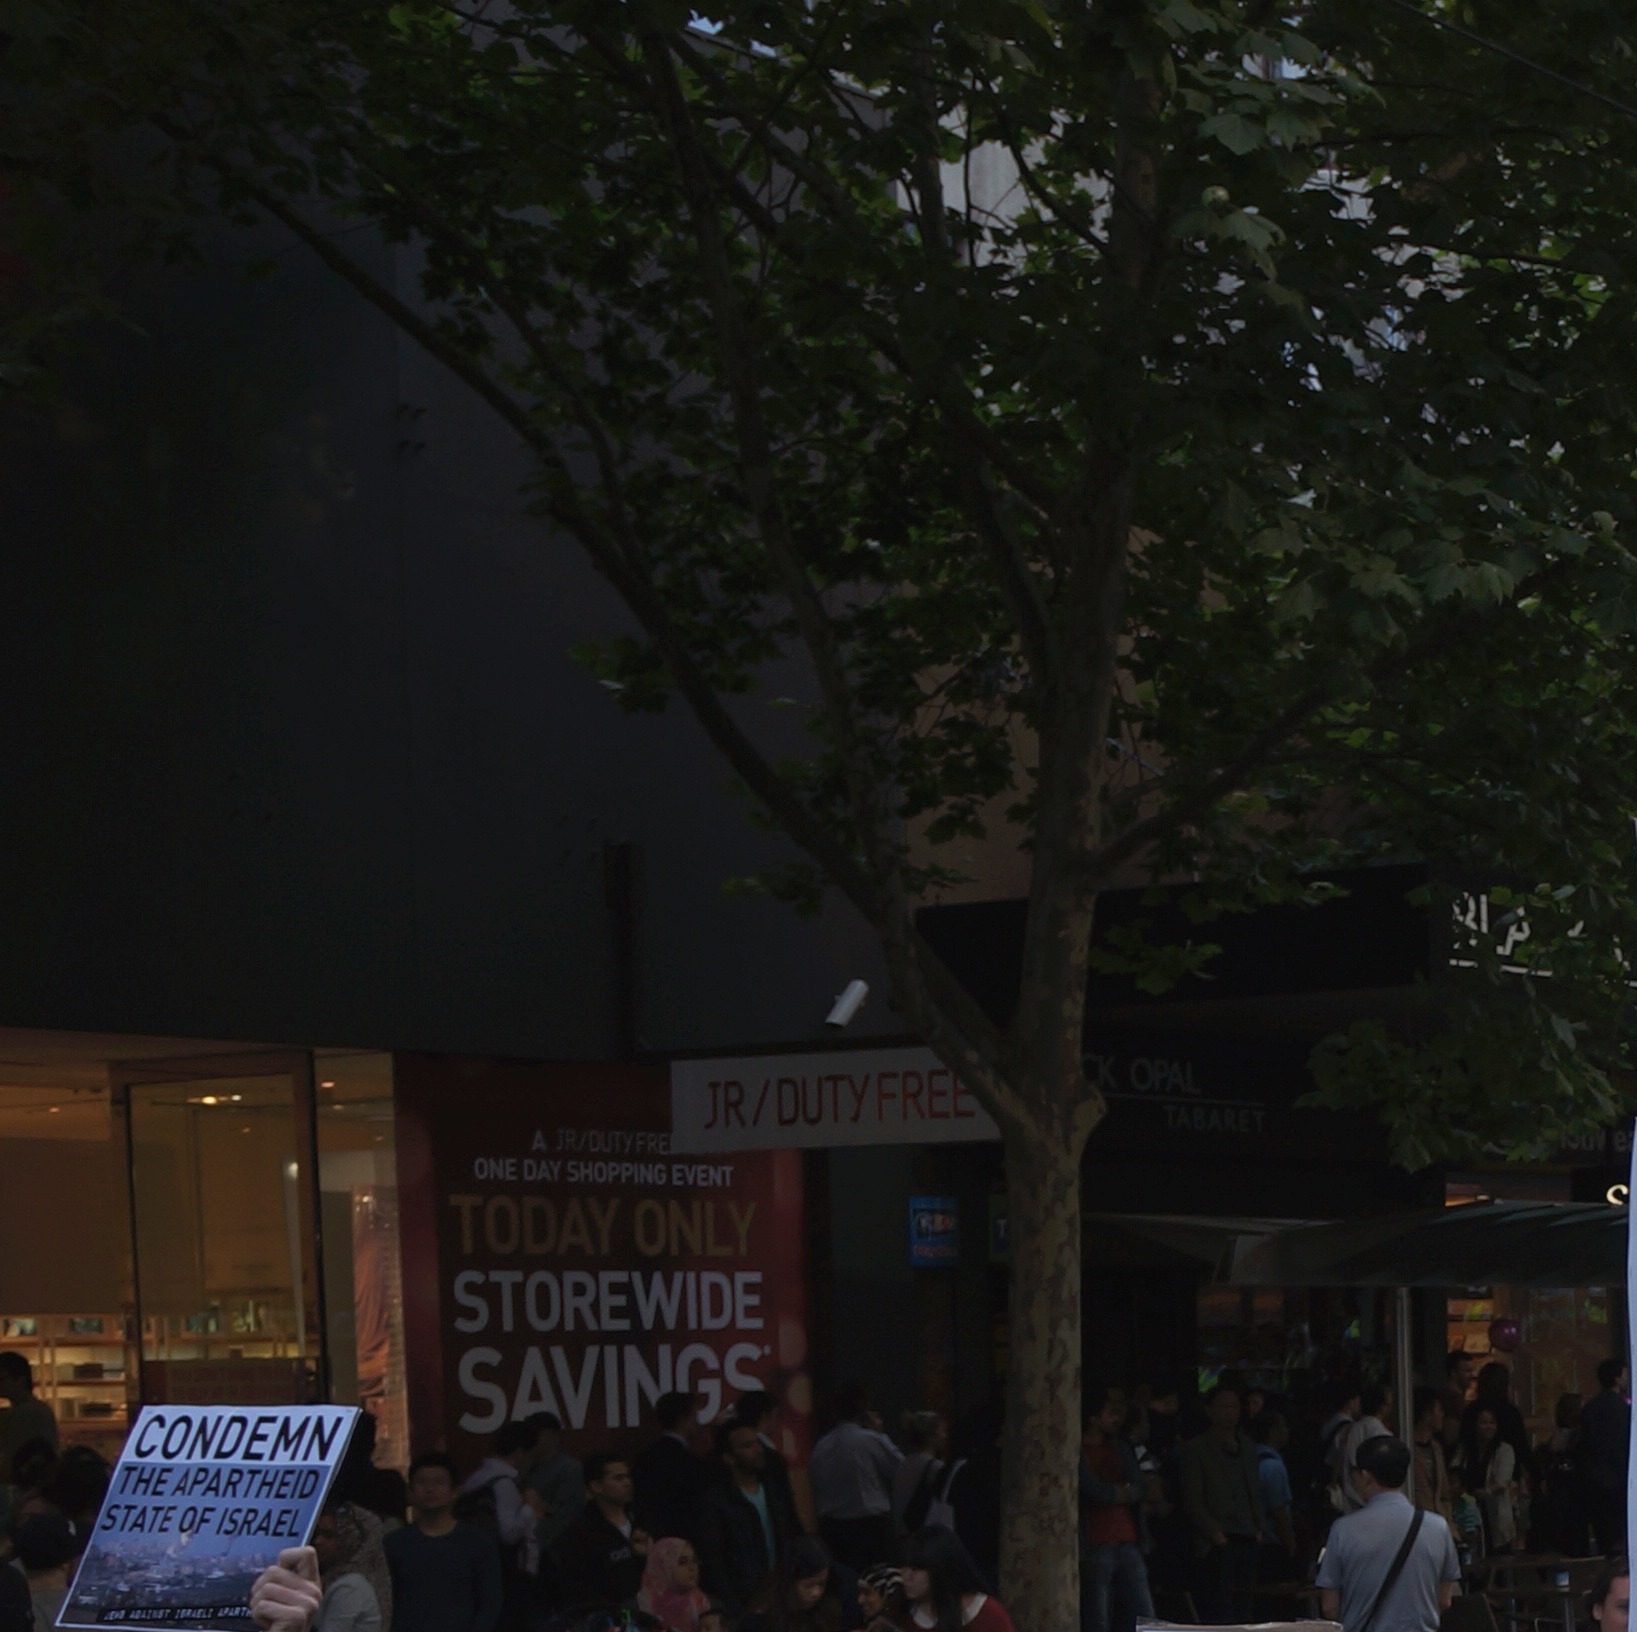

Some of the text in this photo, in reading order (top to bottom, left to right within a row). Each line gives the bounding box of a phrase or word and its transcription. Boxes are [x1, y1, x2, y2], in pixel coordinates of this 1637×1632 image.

[1130, 1057, 1199, 1094] OPAL
[1163, 1104, 1266, 1133] TABARET
[532, 1130, 547, 1151] A
[474, 1157, 733, 1187] ONE DAY SHOPPING EVENT
[450, 1194, 759, 1256] TODAY ONLY
[453, 1270, 764, 1333] STOREWIDE
[135, 1415, 343, 1461] CONDEMN
[119, 1466, 320, 1499] THE APARTHEID
[101, 1504, 300, 1537] STATE OF ISRAEL
